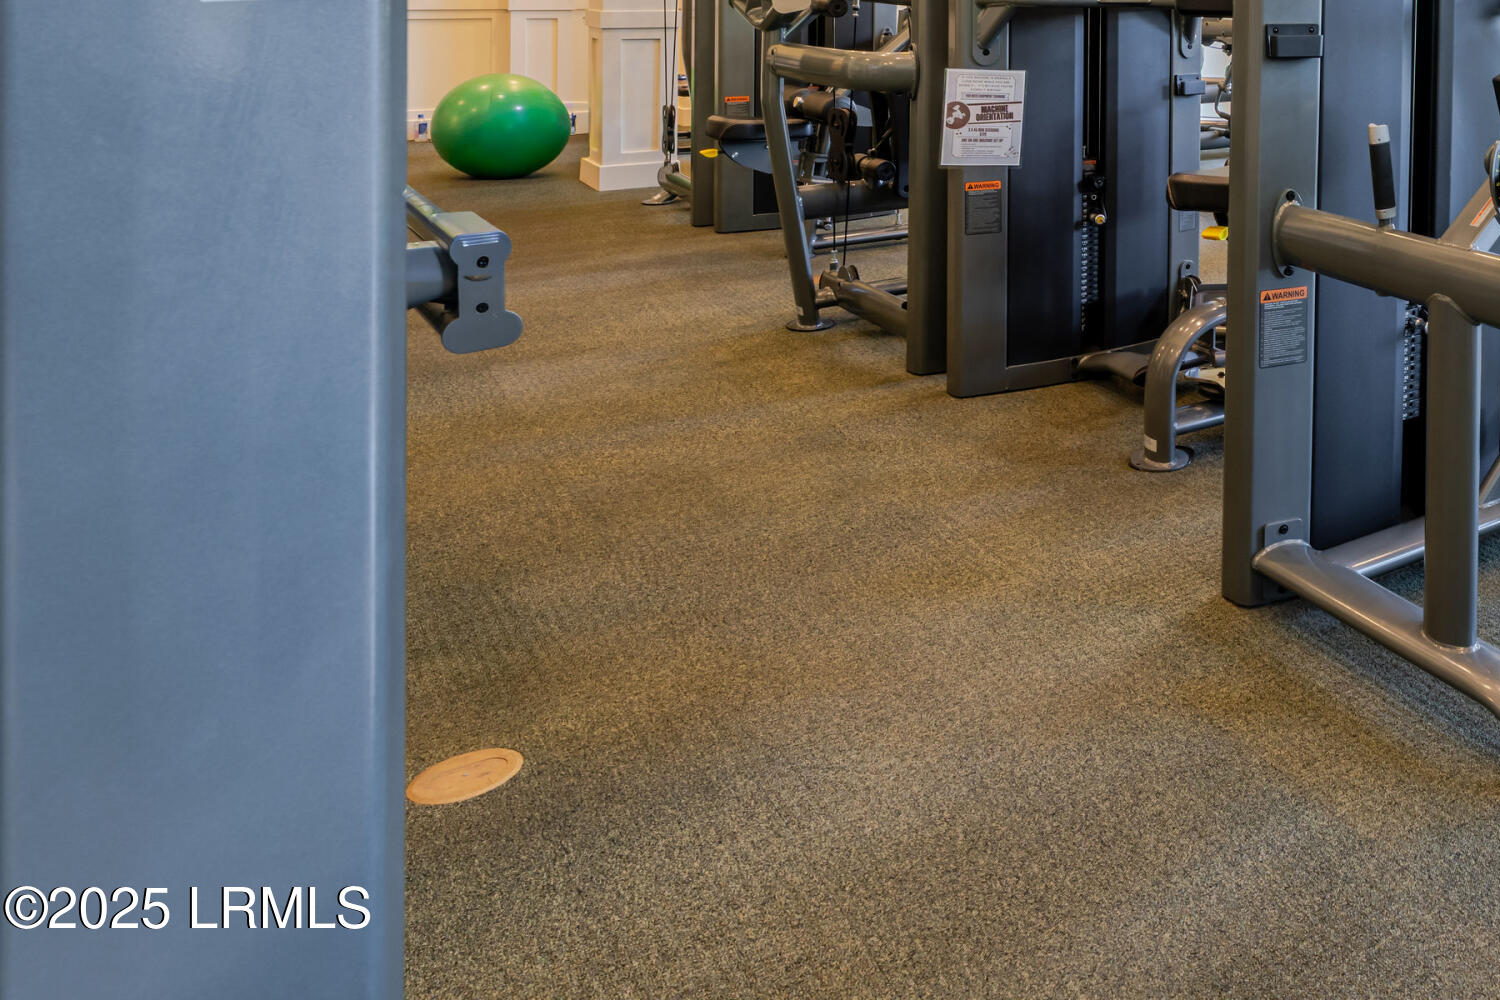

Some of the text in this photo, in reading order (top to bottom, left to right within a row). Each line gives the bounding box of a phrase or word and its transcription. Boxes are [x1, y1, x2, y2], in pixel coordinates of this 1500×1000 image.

[981, 105, 1009, 113] MACHINE
[975, 112, 1014, 121] ORIENTATION
[1271, 289, 1305, 300] WARNING
